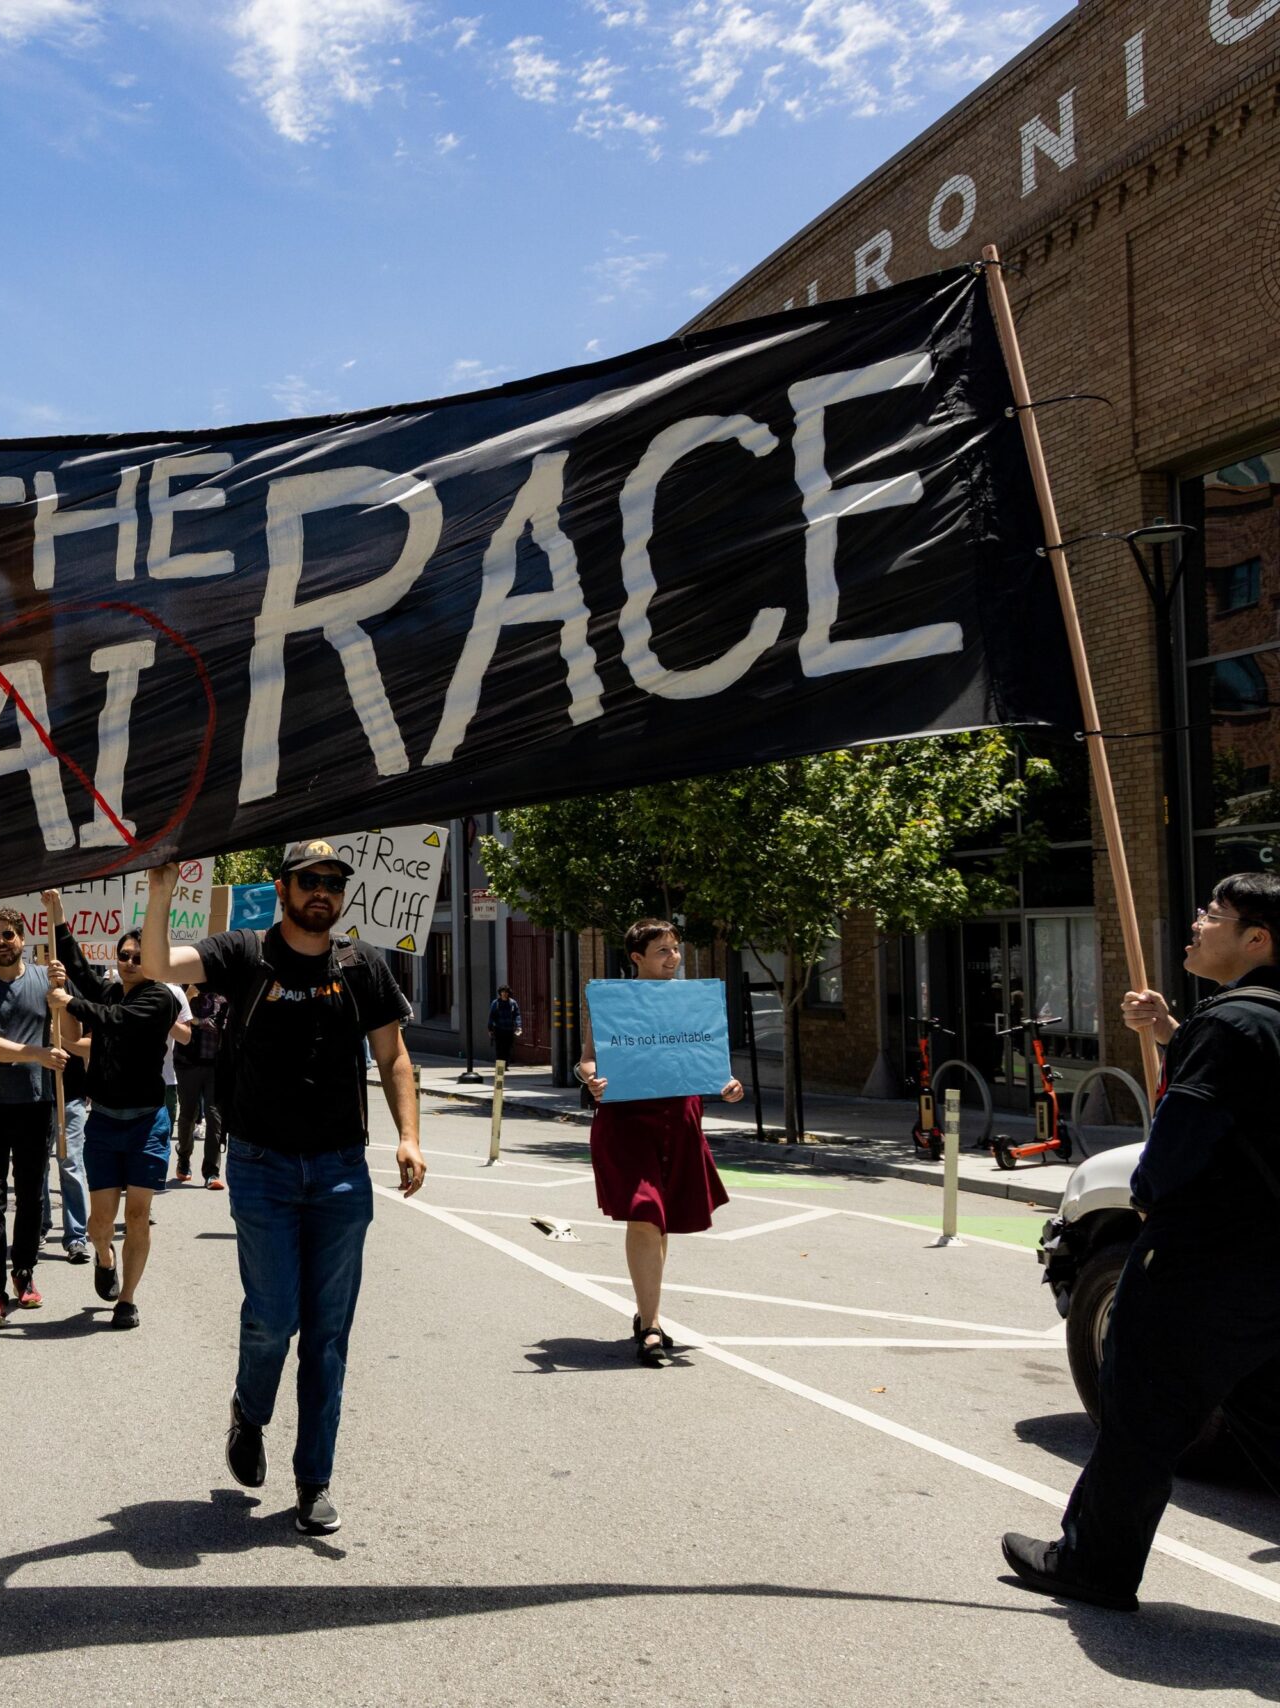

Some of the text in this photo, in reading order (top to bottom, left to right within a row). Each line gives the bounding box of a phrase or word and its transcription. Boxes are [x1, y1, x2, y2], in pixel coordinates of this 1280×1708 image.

[238, 352, 963, 803] RACE
[372, 836, 431, 880] Race
[610, 1031, 715, 1047] AI is not inevitable.
